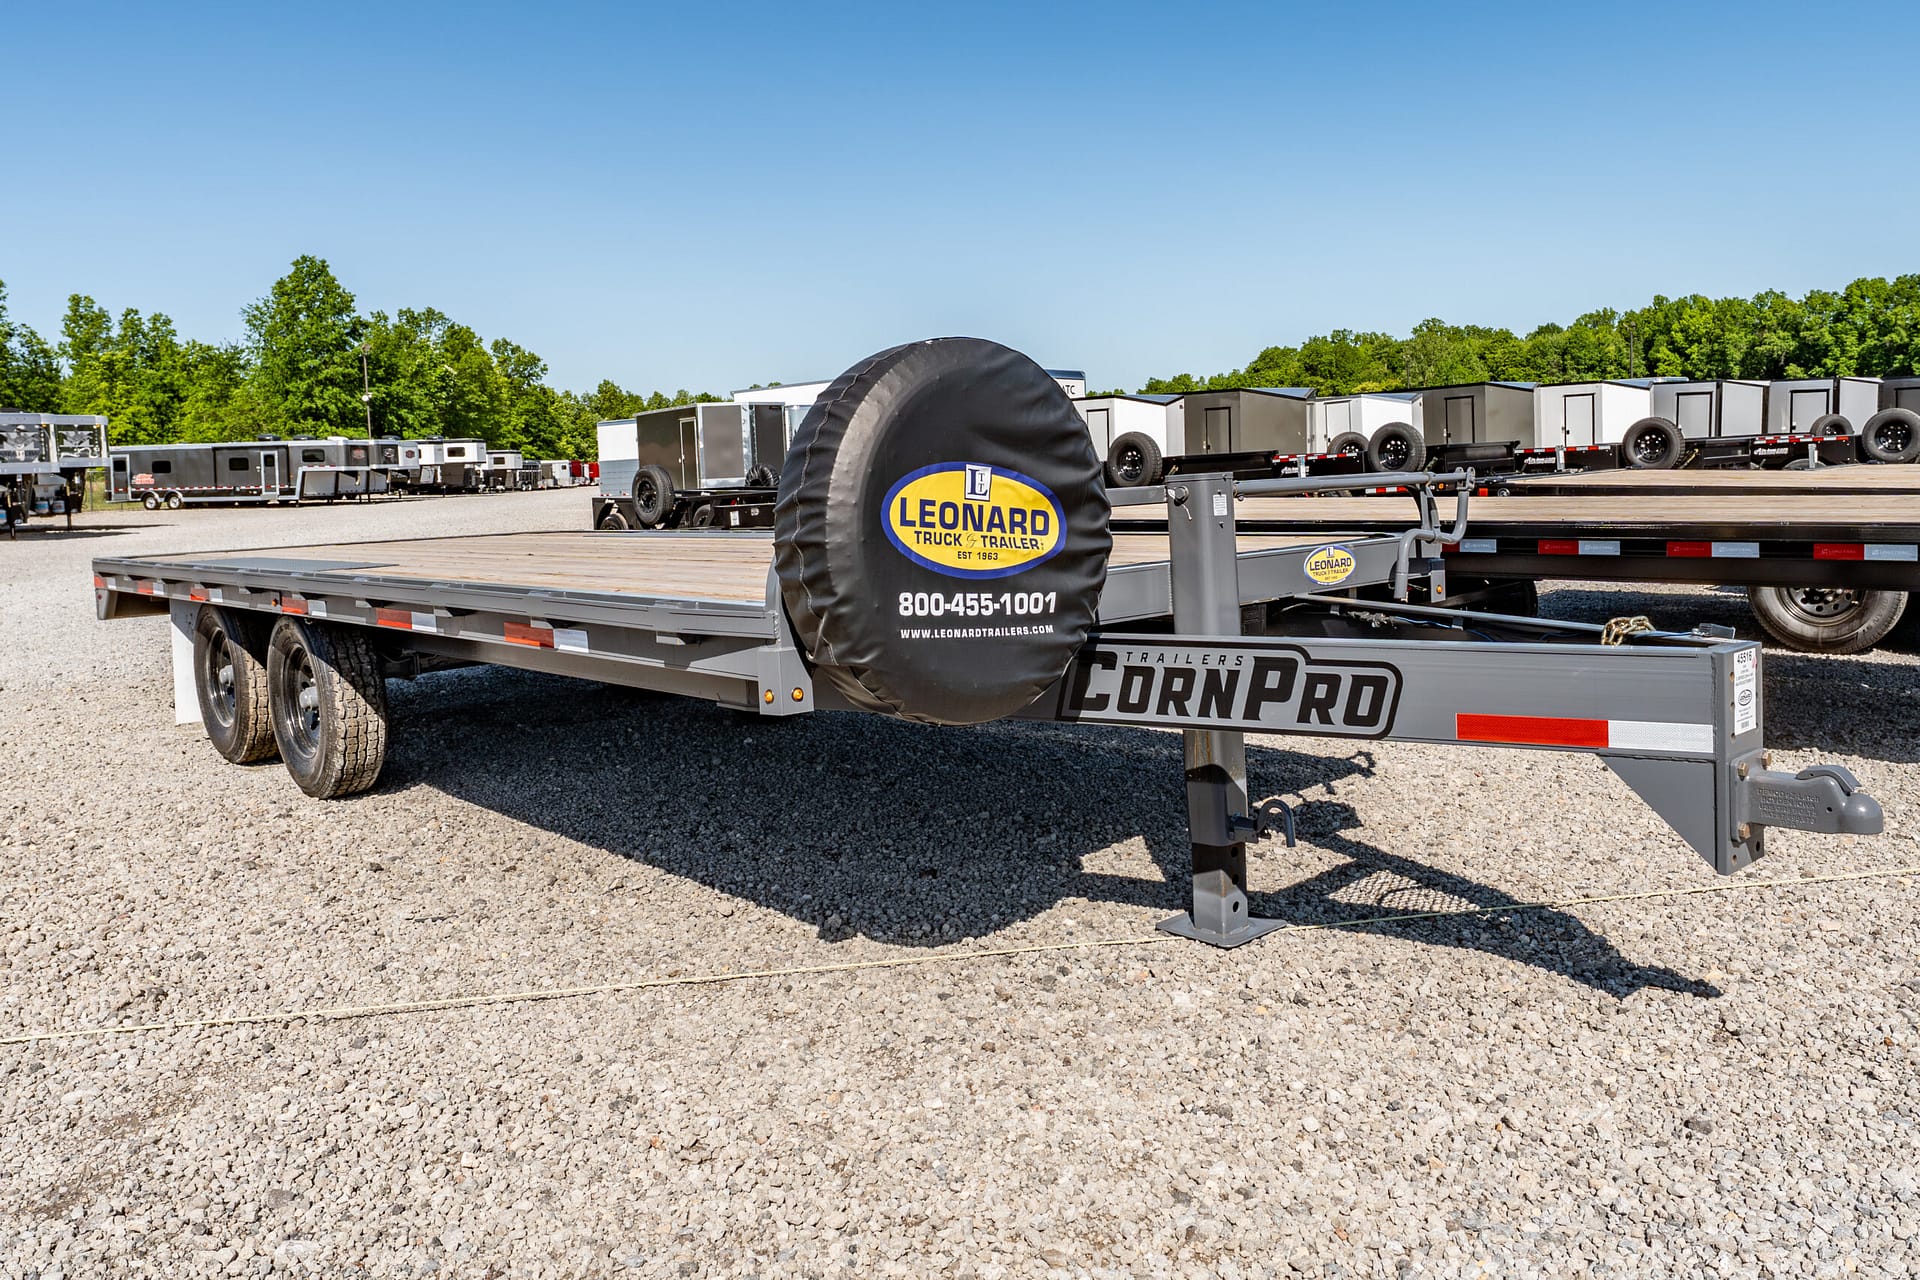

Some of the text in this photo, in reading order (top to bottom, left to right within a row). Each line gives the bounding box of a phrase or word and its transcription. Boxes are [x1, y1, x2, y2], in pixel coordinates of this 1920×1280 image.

[899, 497, 1050, 537] LEONARD
[914, 530, 963, 547] TRUCK
[980, 534, 1040, 551] TRAILER
[957, 550, 999, 561] EST 1963
[1309, 557, 1352, 571] LEONARD
[898, 591, 1057, 617] 800-455-1001
[900, 624, 1054, 639] WWW.LEONARDTRAILERS.COM
[1126, 651, 1245, 667] TRAILERS
[1737, 650, 1753, 664] 45516
